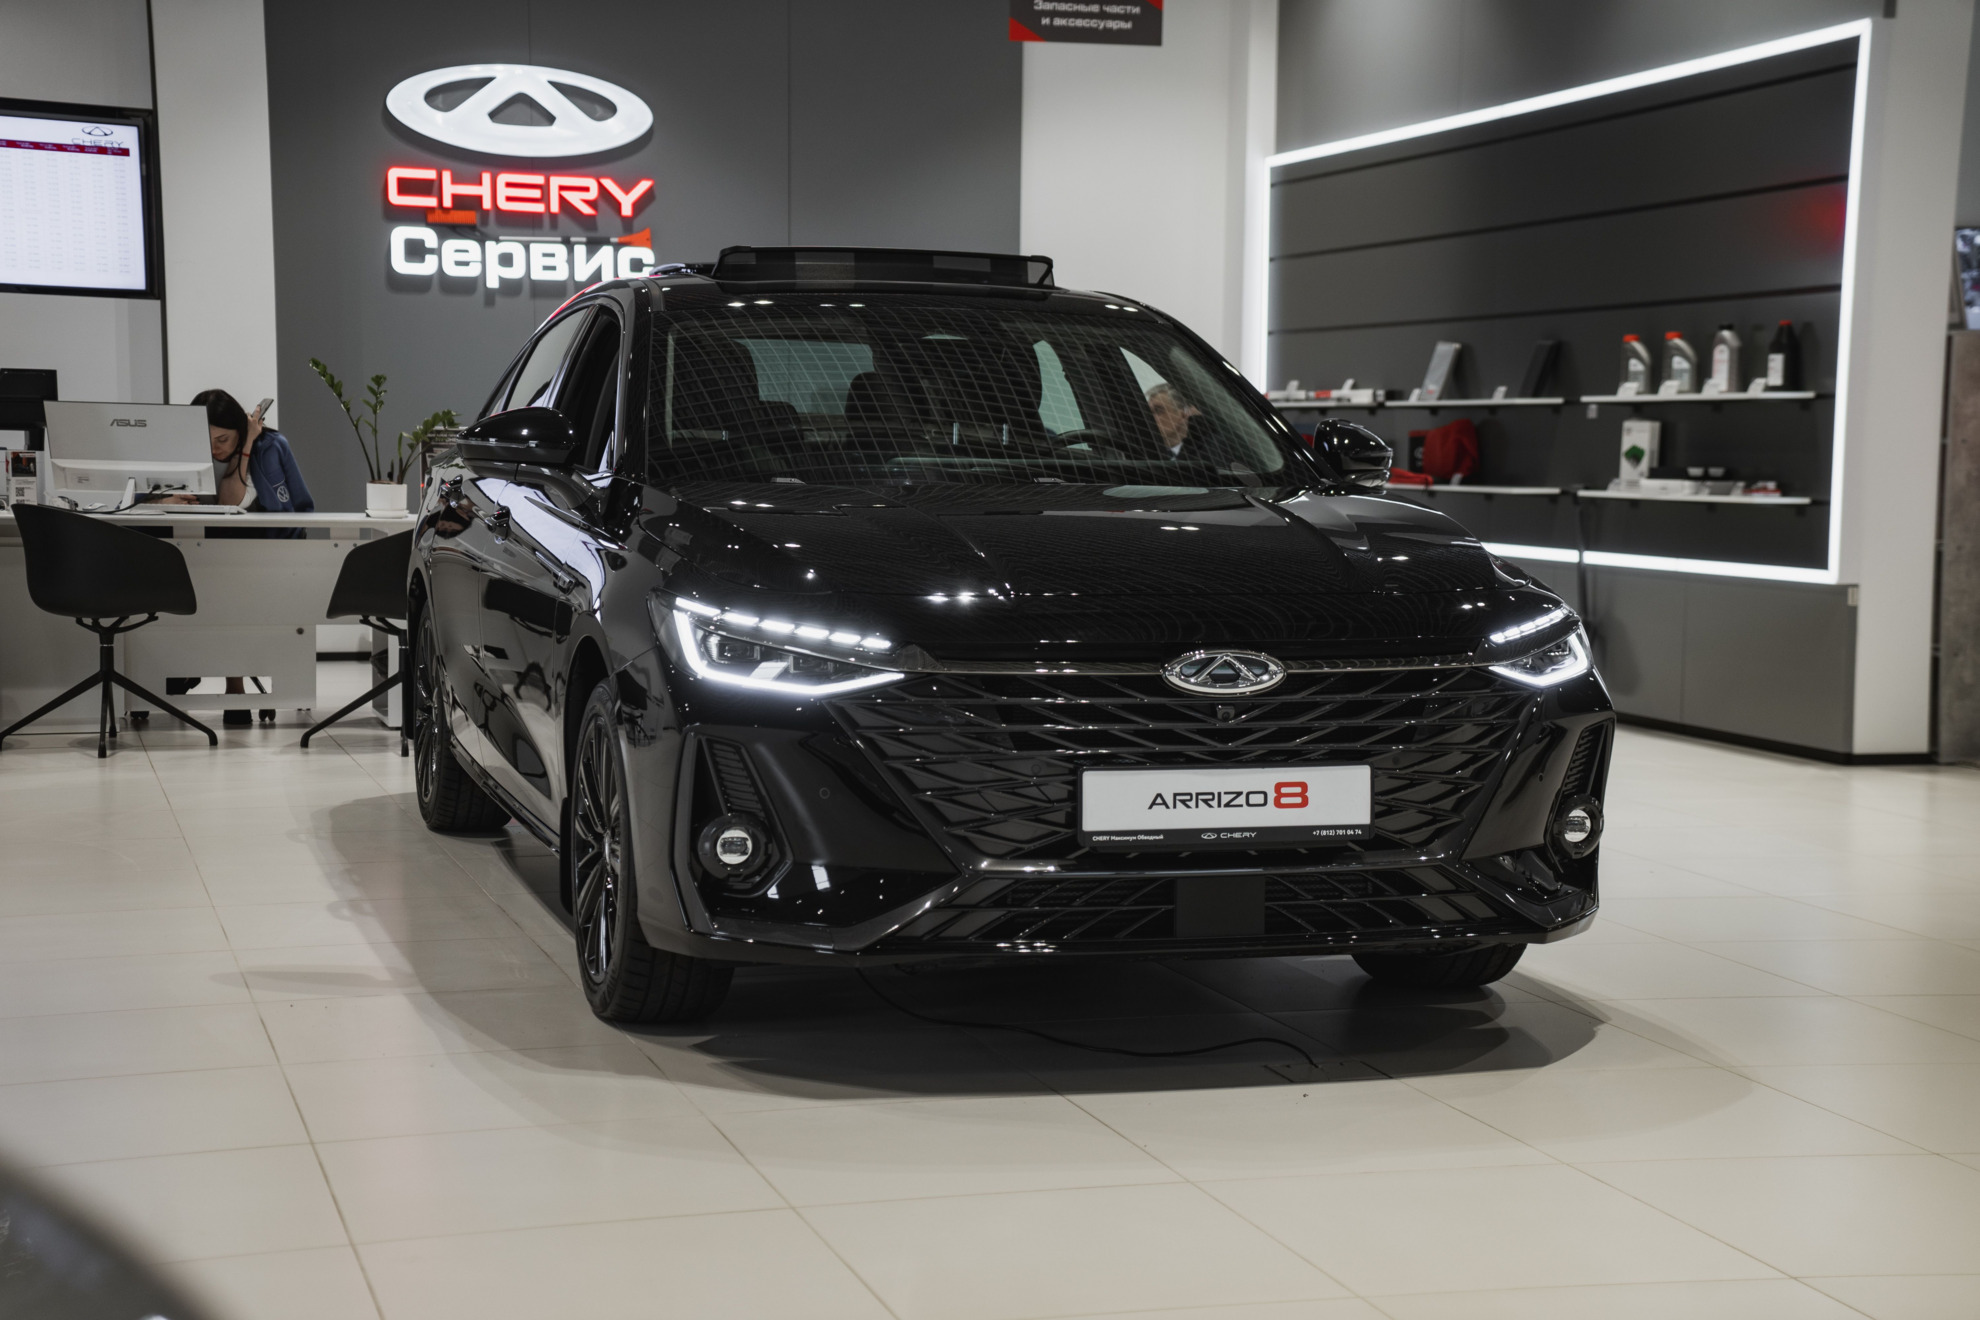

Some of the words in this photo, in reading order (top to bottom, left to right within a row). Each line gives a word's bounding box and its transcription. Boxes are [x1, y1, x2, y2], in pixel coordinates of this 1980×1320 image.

[1033, 0, 1100, 13] Запасные
[1102, 4, 1141, 15] части
[1041, 16, 1050, 25] и
[1052, 17, 1132, 30] аксессуары
[71, 137, 124, 149] CHERY
[387, 166, 655, 217] CHERY
[389, 225, 656, 289] Сервис
[110, 418, 147, 428] ASUS
[1220, 831, 1257, 839] CHERY
